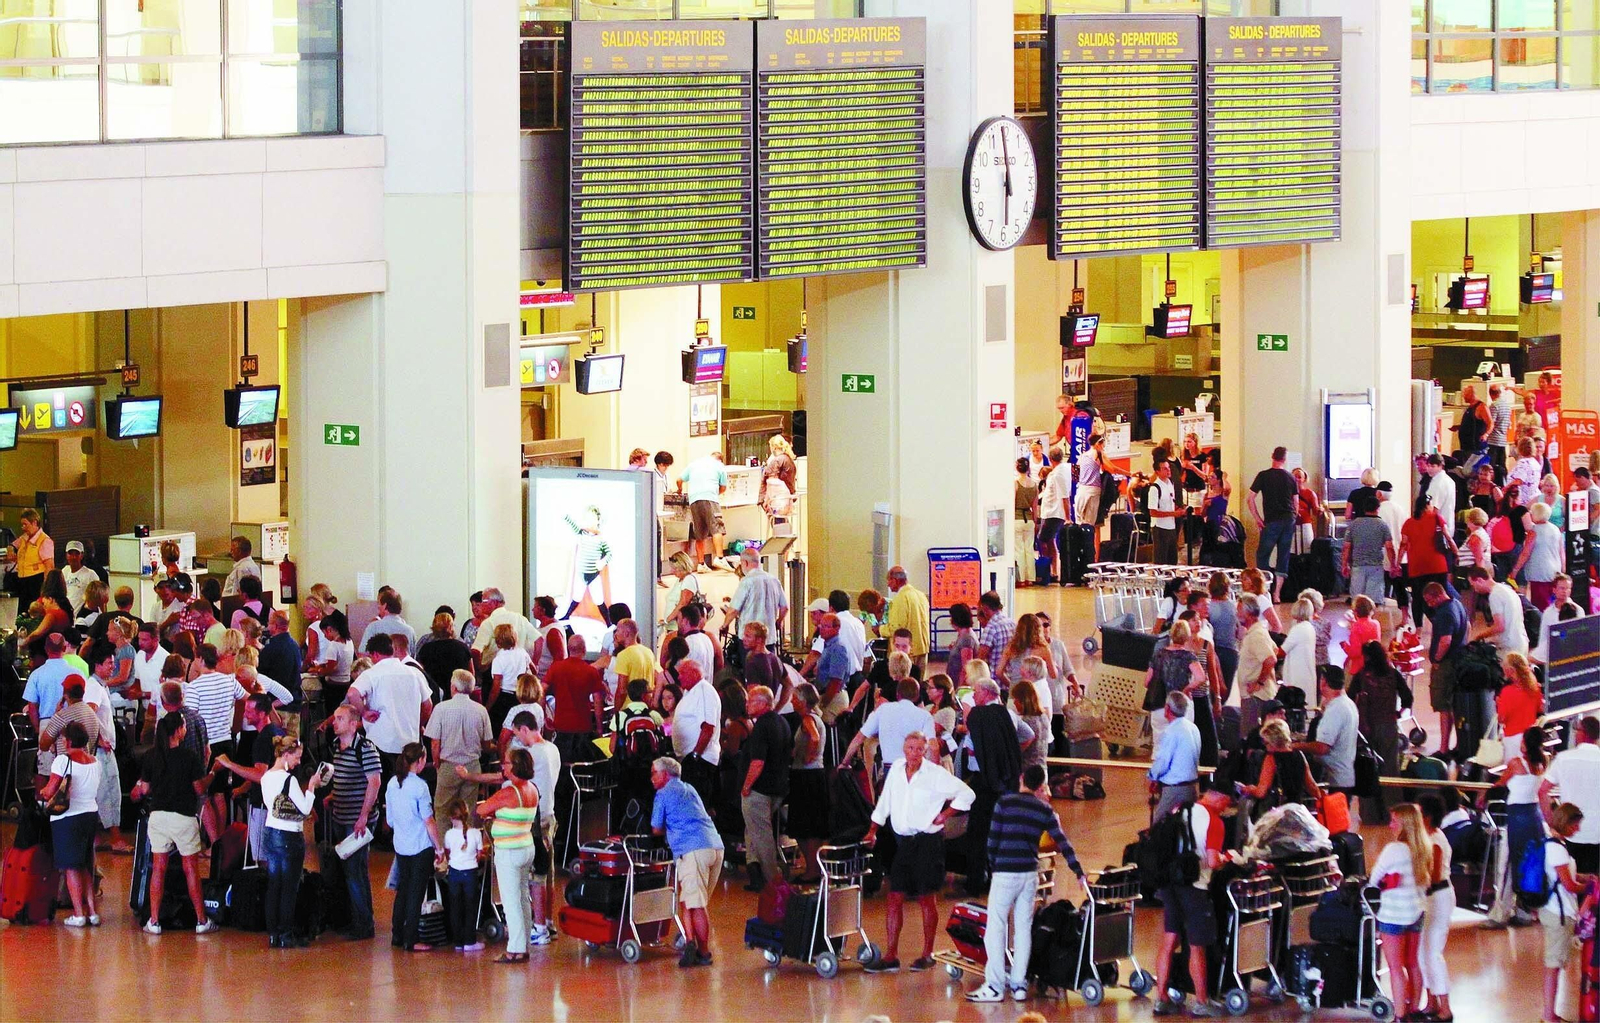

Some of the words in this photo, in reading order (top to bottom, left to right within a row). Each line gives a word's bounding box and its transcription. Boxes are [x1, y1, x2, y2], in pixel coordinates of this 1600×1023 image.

[988, 134, 995, 149] 11
[979, 152, 988, 167] 10
[1024, 151, 1029, 167] 2
[974, 178, 980, 193] 9
[1028, 176, 1034, 191] 3
[978, 201, 984, 217] 8
[1023, 200, 1028, 215] 4
[988, 219, 993, 235] 7
[1014, 218, 1020, 234] 5
[1000, 226, 1006, 242] 6
[242, 360, 256, 372] 246
[124, 369, 138, 381] 245
[1565, 421, 1596, 435] MÁS
